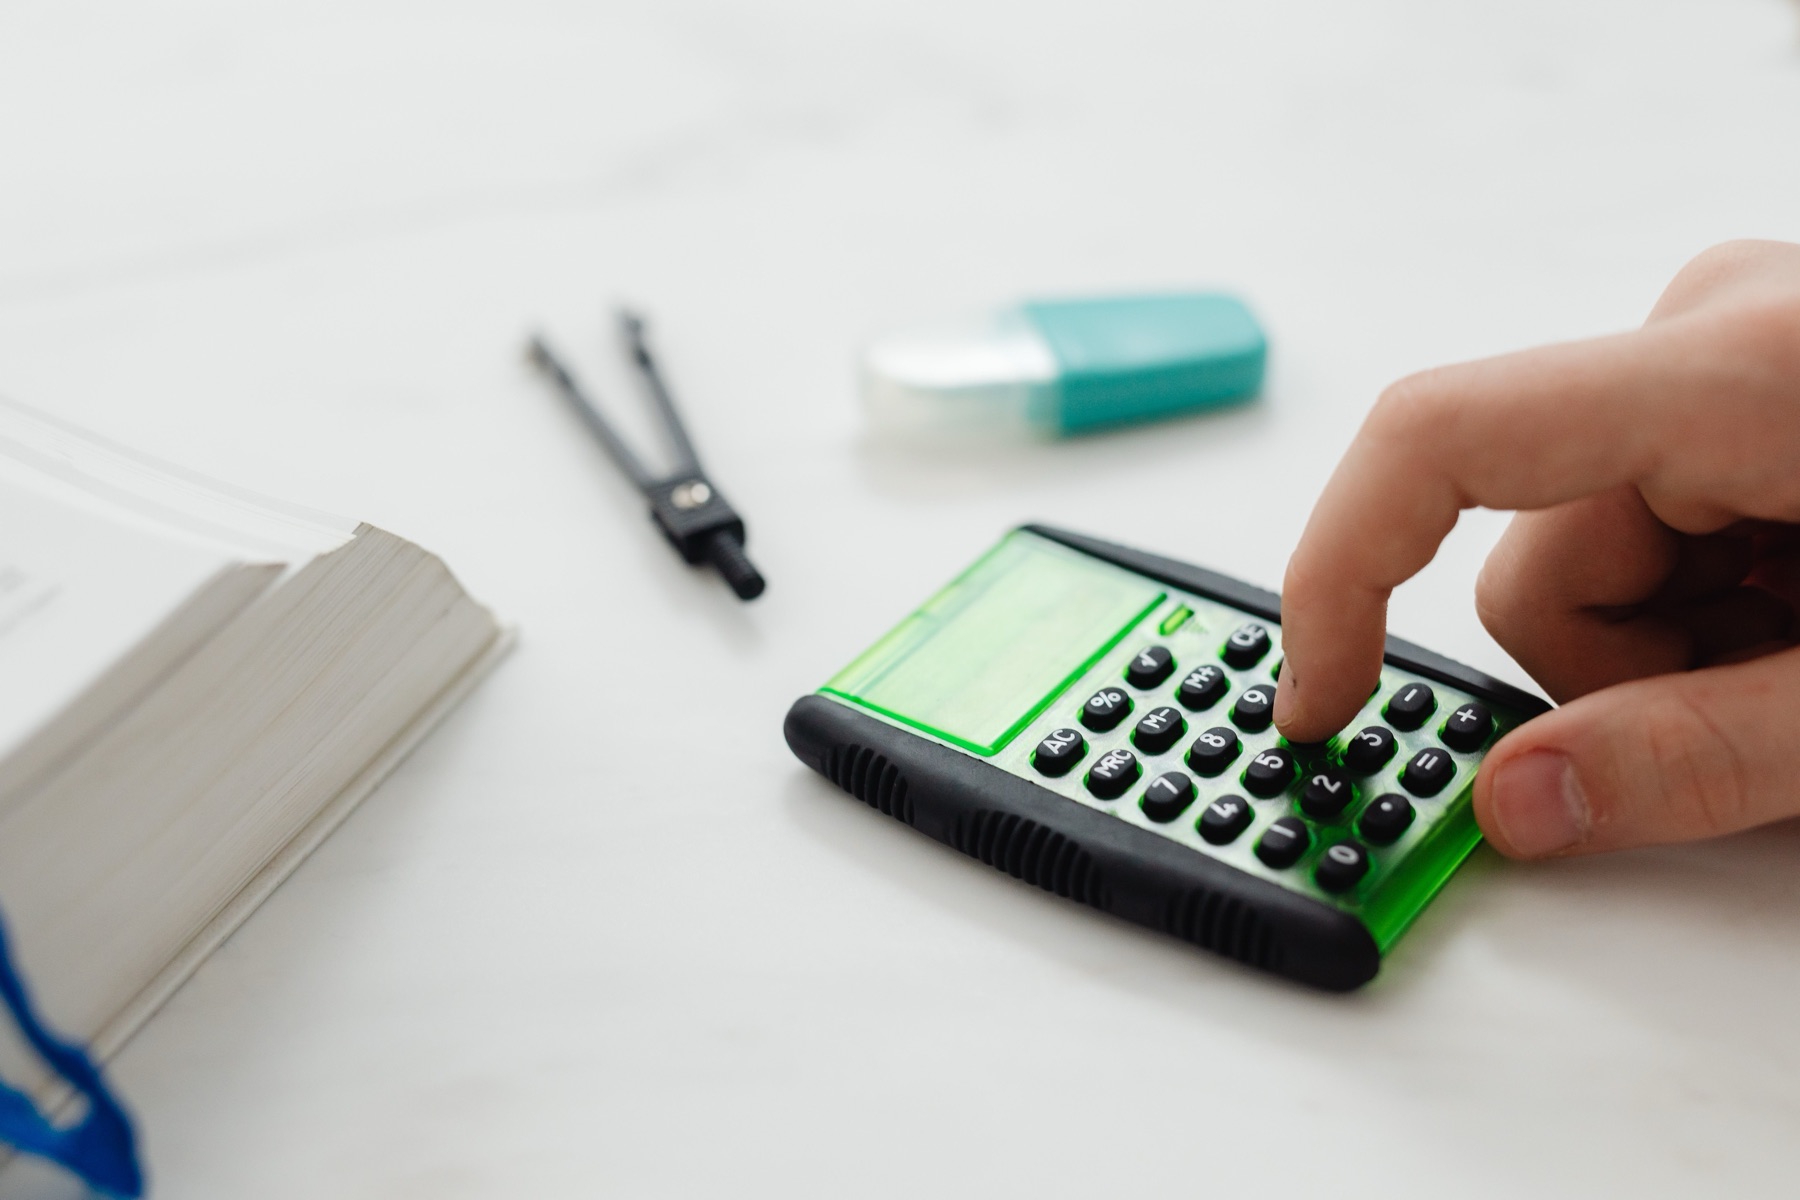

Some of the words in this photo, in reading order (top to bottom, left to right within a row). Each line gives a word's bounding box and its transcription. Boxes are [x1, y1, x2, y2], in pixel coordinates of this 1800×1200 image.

[1185, 666, 1215, 689] M+
[1090, 691, 1121, 708] %
[1242, 689, 1268, 705] 9
[1143, 708, 1170, 729] M-
[1043, 729, 1075, 754] AC
[1199, 732, 1226, 748] 8
[1355, 731, 1383, 747] 3
[1093, 749, 1132, 777] MRC
[1254, 752, 1284, 769] 5
[1151, 776, 1179, 795] 7
[1312, 774, 1342, 794] 2
[1209, 801, 1239, 819] 4
[1269, 823, 1297, 839] 1
[1328, 845, 1359, 865] 0
